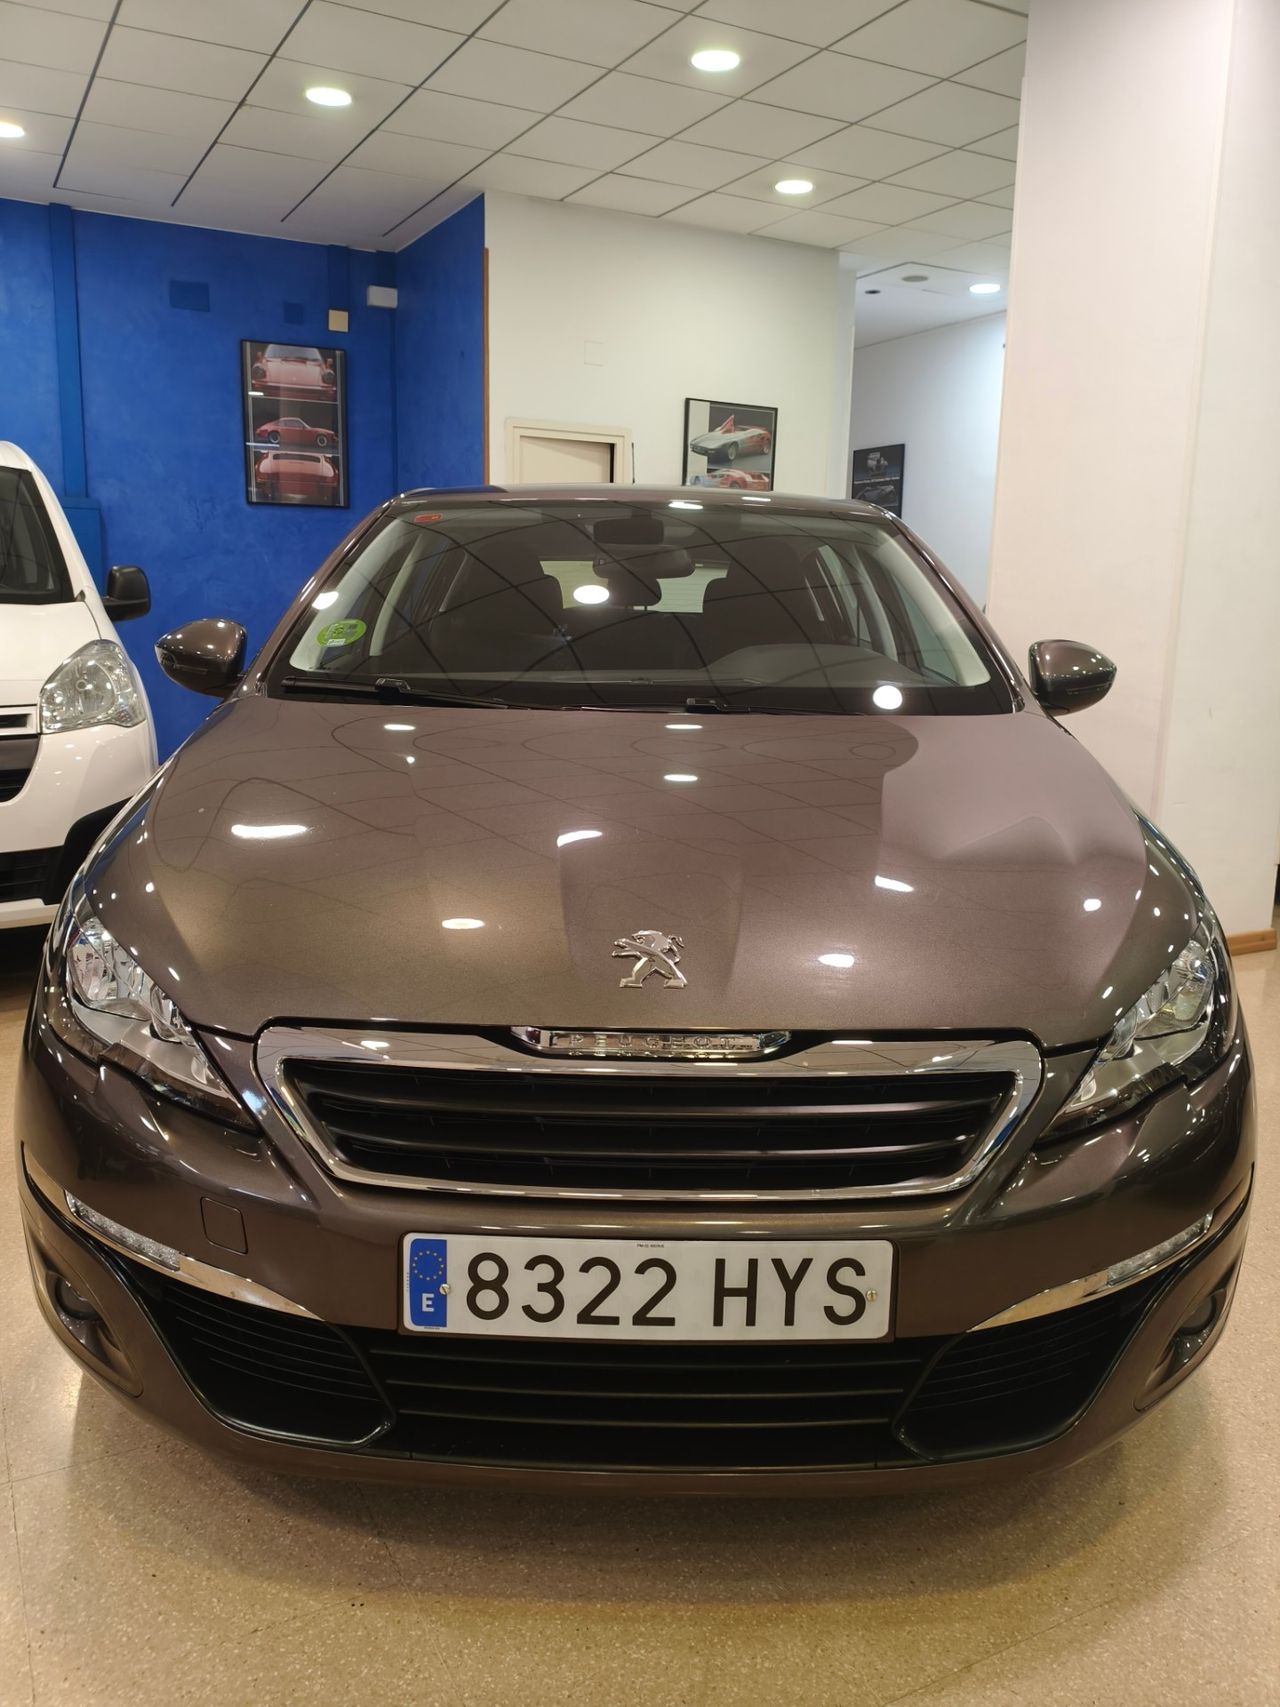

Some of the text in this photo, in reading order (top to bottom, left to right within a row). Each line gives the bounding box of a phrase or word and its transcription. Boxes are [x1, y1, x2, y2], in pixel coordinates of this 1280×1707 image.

[569, 1034, 736, 1049] PEUGEOT
[466, 1252, 867, 1327] 8322 HYS
[421, 1293, 435, 1313] E
